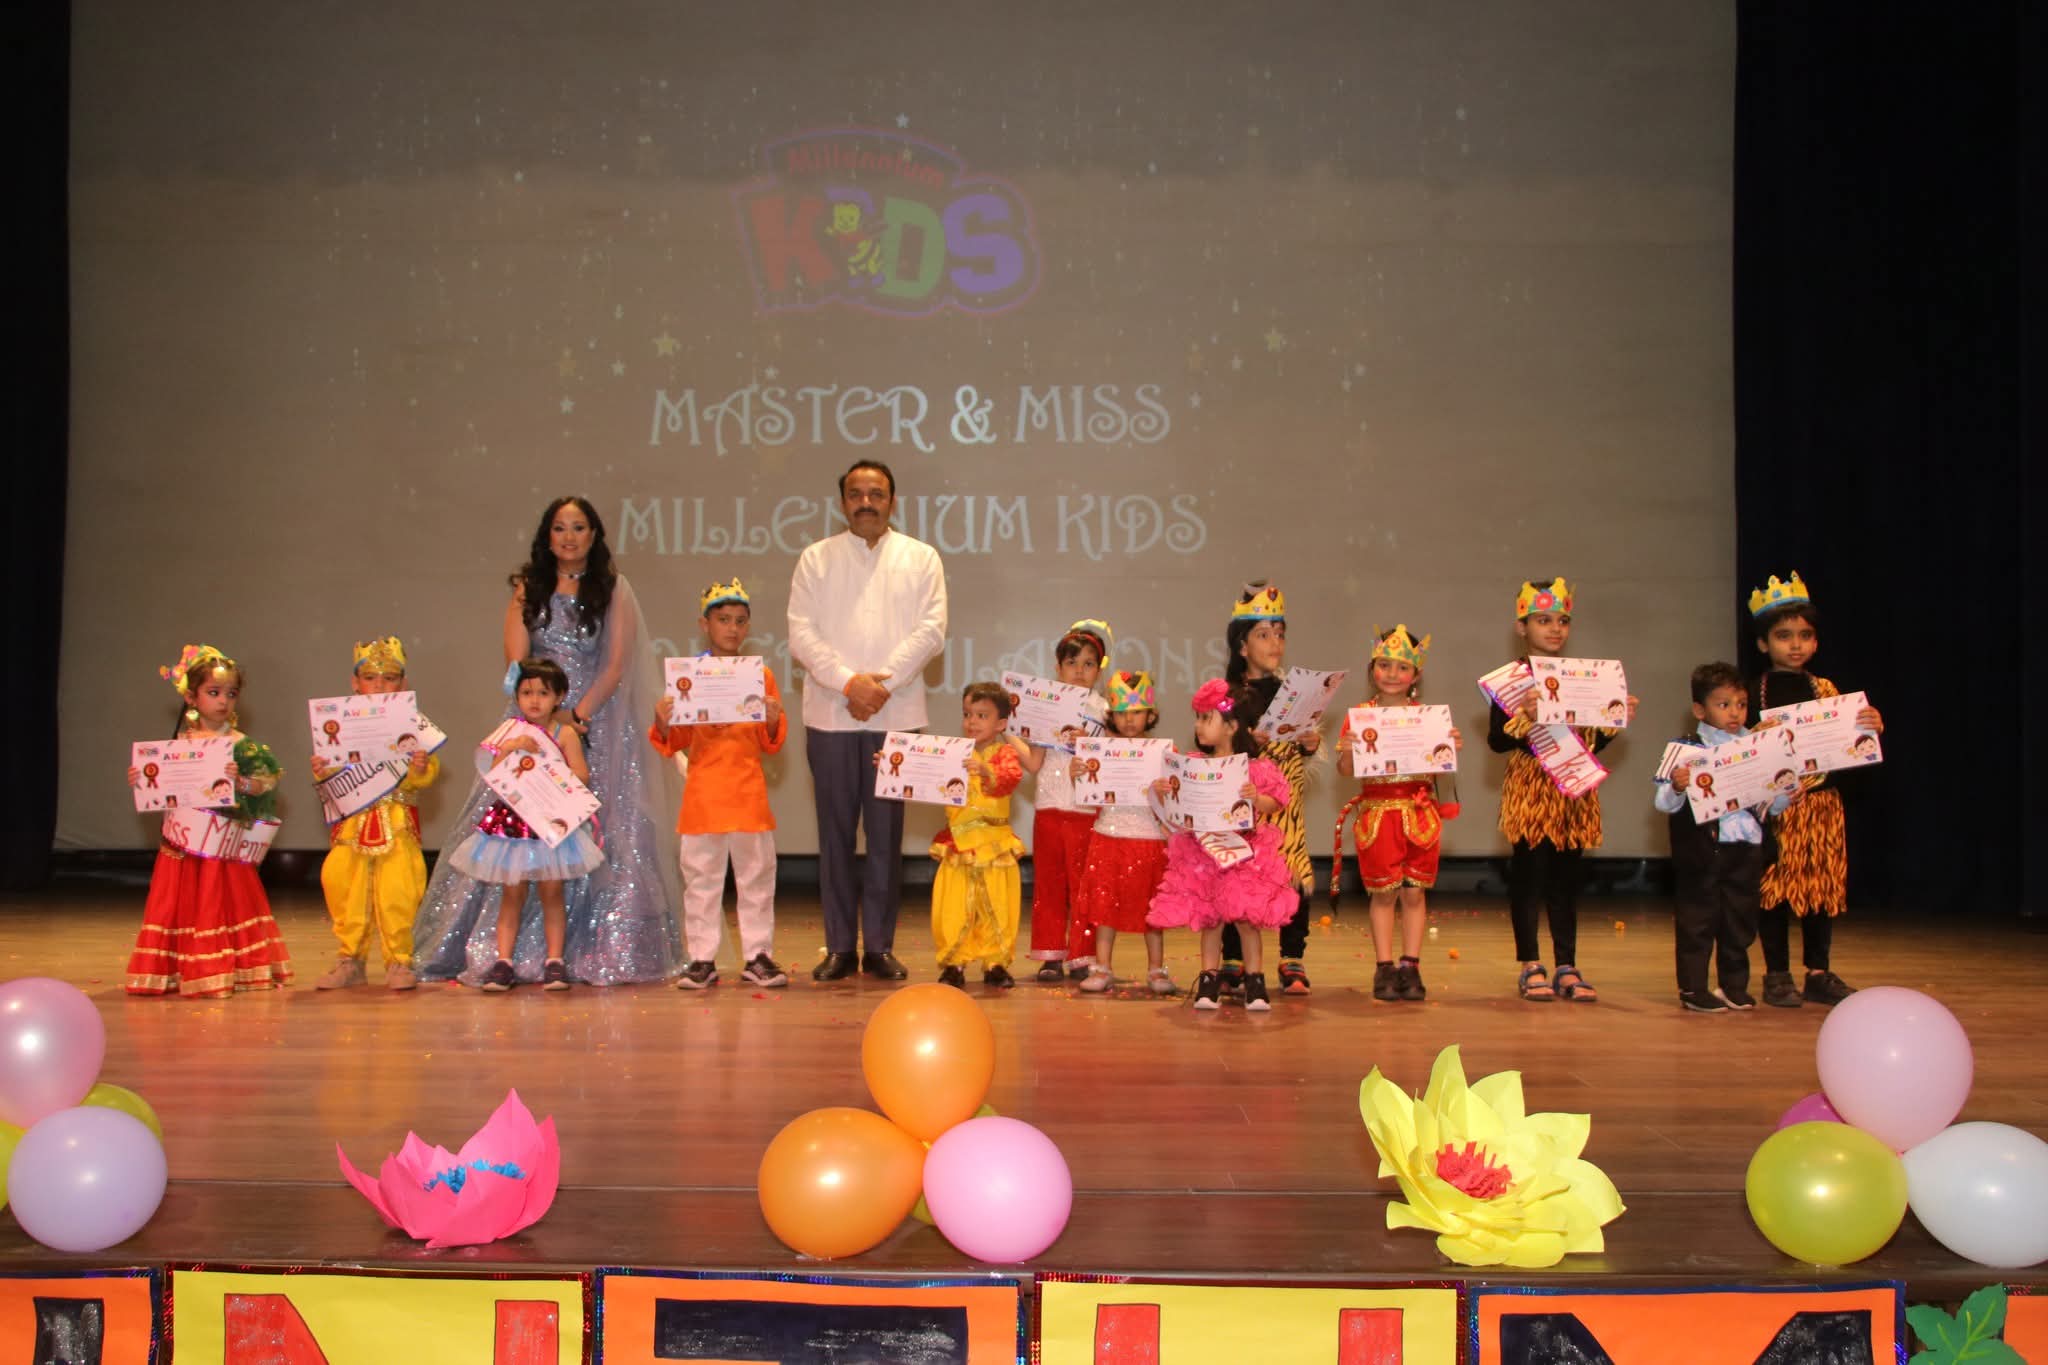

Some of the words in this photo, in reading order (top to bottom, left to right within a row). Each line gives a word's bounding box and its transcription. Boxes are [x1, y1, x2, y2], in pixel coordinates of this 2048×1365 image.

[649, 383, 936, 456] MASTER
[950, 384, 998, 445] &
[1014, 383, 1171, 444] MISS
[1056, 494, 1208, 561] KIDS
[163, 751, 204, 761] AWARD
